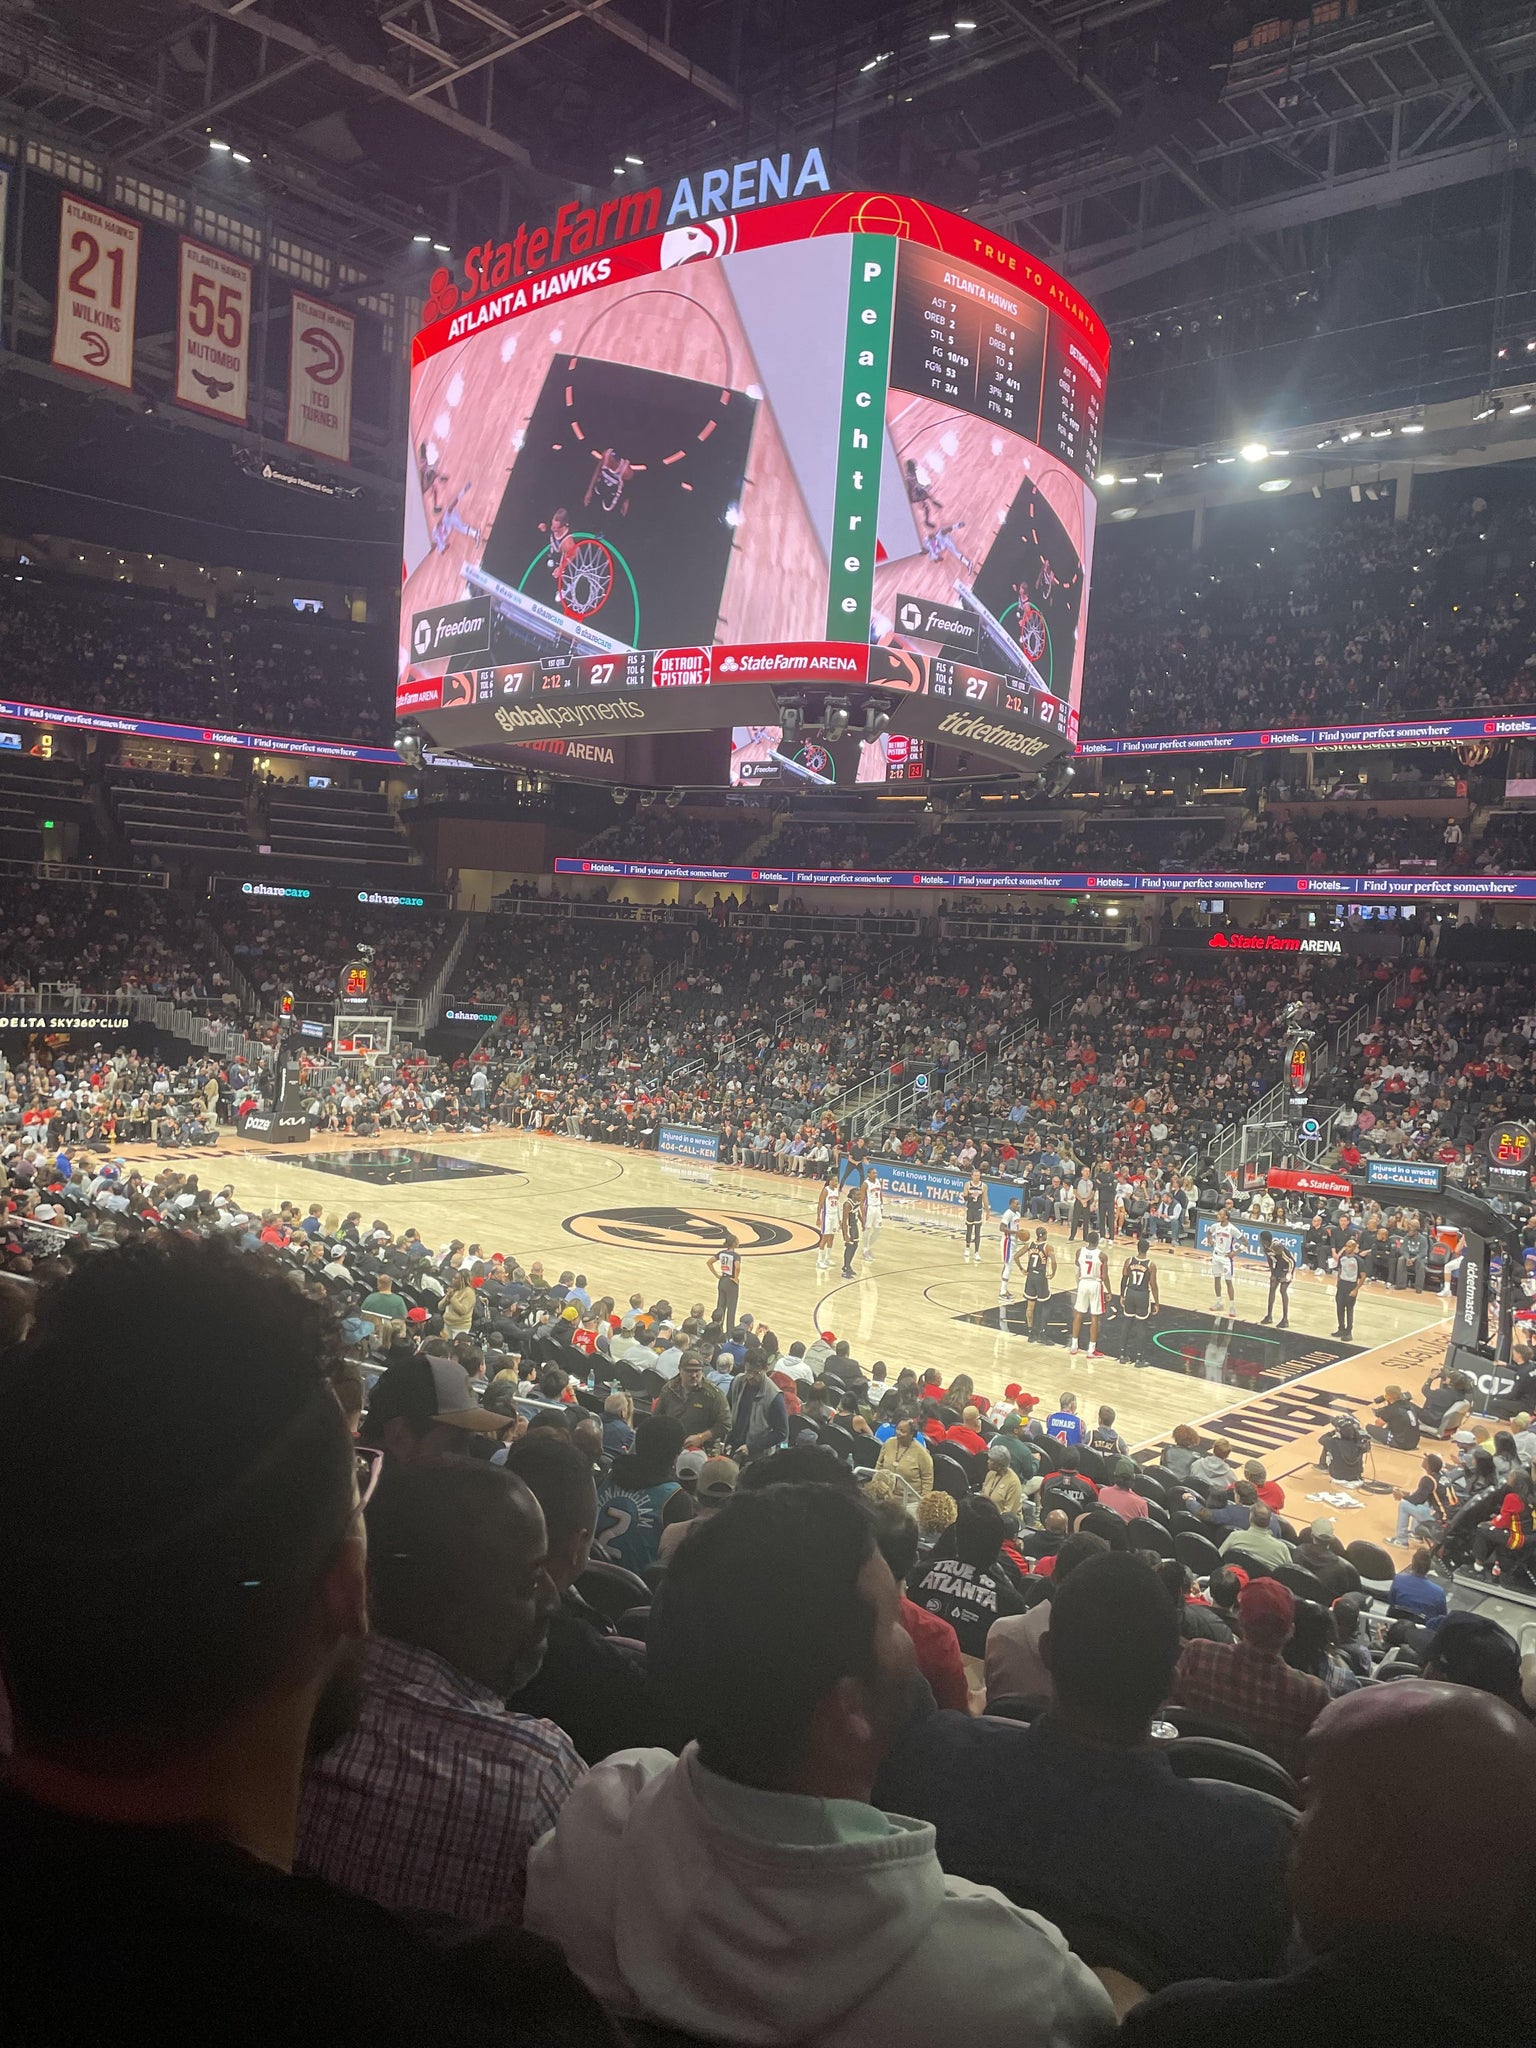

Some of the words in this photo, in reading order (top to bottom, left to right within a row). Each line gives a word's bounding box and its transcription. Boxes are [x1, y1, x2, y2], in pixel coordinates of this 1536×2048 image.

[666, 147, 831, 226] ARENA
[66, 205, 103, 229] ATLANTA
[69, 231, 124, 309] 21
[943, 272, 986, 298] ATLANTA
[987, 291, 1018, 315] HAWKS
[973, 238, 1016, 270] TRUE
[1025, 267, 1042, 286] TO
[1049, 285, 1095, 335] ATLANTA
[447, 287, 528, 341] ATLANTA
[532, 257, 612, 304] HAWKS
[932, 297, 947, 309] AST
[951, 304, 957, 313] 7
[72, 300, 121, 333] WILKINS
[189, 273, 242, 348] 55
[924, 310, 946, 325] OREB
[949, 320, 955, 329] 2
[930, 329, 945, 342] STL
[948, 336, 954, 345] 5
[995, 323, 1008, 337] BLK
[989, 336, 1006, 351] DREB
[1009, 347, 1014, 356] 6
[187, 339, 240, 372] MUTOMBO
[932, 346, 943, 358] FG
[947, 352, 969, 367] 10/19
[925, 360, 942, 373] FG%
[946, 367, 956, 378] 53
[996, 356, 1005, 367] TO
[1007, 362, 1013, 371] 3
[931, 378, 941, 389] FT
[945, 383, 958, 395] 3/4
[995, 371, 1004, 382] 3P
[1006, 377, 1021, 391] 4/11
[312, 391, 330, 409] TED
[1005, 393, 1014, 403] 36
[301, 404, 338, 429] TURNER
[1004, 407, 1013, 419] 75
[842, 262, 882, 613] Peachtree
[433, 615, 482, 648] freedom
[925, 612, 973, 637] freedom
[627, 656, 638, 664] FLS
[641, 655, 646, 663] 3
[661, 656, 703, 671] DETROIT
[809, 657, 857, 671] ARENA
[591, 663, 614, 685] 27
[627, 665, 638, 674] TOL
[639, 665, 645, 674] 6
[936, 662, 946, 672] FLS
[949, 665, 954, 675] 4
[503, 673, 523, 693] 27
[542, 674, 561, 690] 2:12
[626, 676, 638, 685] CHL
[660, 671, 703, 686] PISTONS
[935, 673, 947, 684] TOL
[948, 676, 953, 685] 6
[419, 690, 439, 702] ARENA
[934, 684, 946, 695] CHL
[966, 677, 988, 700] 27
[1006, 694, 1021, 712] 2:12
[1040, 701, 1054, 723] 27
[938, 712, 1049, 757] ticketmaster
[1318, 731, 1339, 742] Find
[1340, 730, 1362, 742] your
[1362, 728, 1395, 741] perfect
[254, 738, 271, 747] Find
[272, 742, 290, 751] your
[290, 742, 315, 753] perfect
[1123, 742, 1140, 751] Find
[1141, 741, 1159, 751] your
[1159, 739, 1187, 750] perfect
[566, 742, 615, 764] ARENA
[889, 769, 904, 779] 2:12
[630, 865, 647, 874] Find
[648, 867, 664, 876] your
[664, 868, 689, 876] perfect
[797, 873, 813, 881] Find
[813, 875, 829, 883] your
[829, 874, 854, 884] perfect
[958, 876, 975, 884] Find
[975, 877, 992, 886] your
[993, 877, 1018, 886] perfect
[1142, 878, 1161, 887] Find
[1162, 880, 1182, 889] your
[1182, 879, 1213, 890] perfect
[253, 885, 310, 898] sharecare
[1364, 880, 1387, 891] Find
[1388, 882, 1413, 893] your
[1414, 881, 1451, 893] perfect
[369, 893, 424, 906] sharecare
[1300, 939, 1342, 953] ARENA
[347, 978, 366, 993] 24
[0, 1017, 46, 1028] DELTA
[100, 1018, 129, 1028] CLUB
[454, 1010, 498, 1022] sharecare
[244, 1116, 271, 1131] paze
[662, 1132, 683, 1142] Injured
[1501, 1134, 1527, 1148] 2:12
[660, 1142, 715, 1157] 404-CALL-KEN
[1498, 1145, 1521, 1161] 24
[892, 1168, 905, 1178] Ken
[906, 1171, 927, 1181] knows
[928, 1174, 942, 1184] how
[943, 1177, 950, 1185] to
[951, 1178, 964, 1187] win
[1373, 1165, 1397, 1173] Injured
[1411, 1168, 1436, 1177] wreck?
[1371, 1172, 1436, 1186] 404-CALL-KEN
[891, 1180, 923, 1198] CALL,
[926, 1186, 965, 1203] THAT'S
[1031, 1254, 1039, 1268] 7
[1085, 1261, 1093, 1275] 7
[1131, 1271, 1144, 1285] 17
[1464, 1261, 1479, 1326] ticketmaster
[1051, 1418, 1076, 1430] DUMARS
[1055, 1431, 1068, 1447] 4
[593, 1507, 632, 1559] 2
[933, 1560, 976, 1580] TRUE
[979, 1574, 996, 1589] TO
[919, 1571, 998, 1613] ATLANTA
